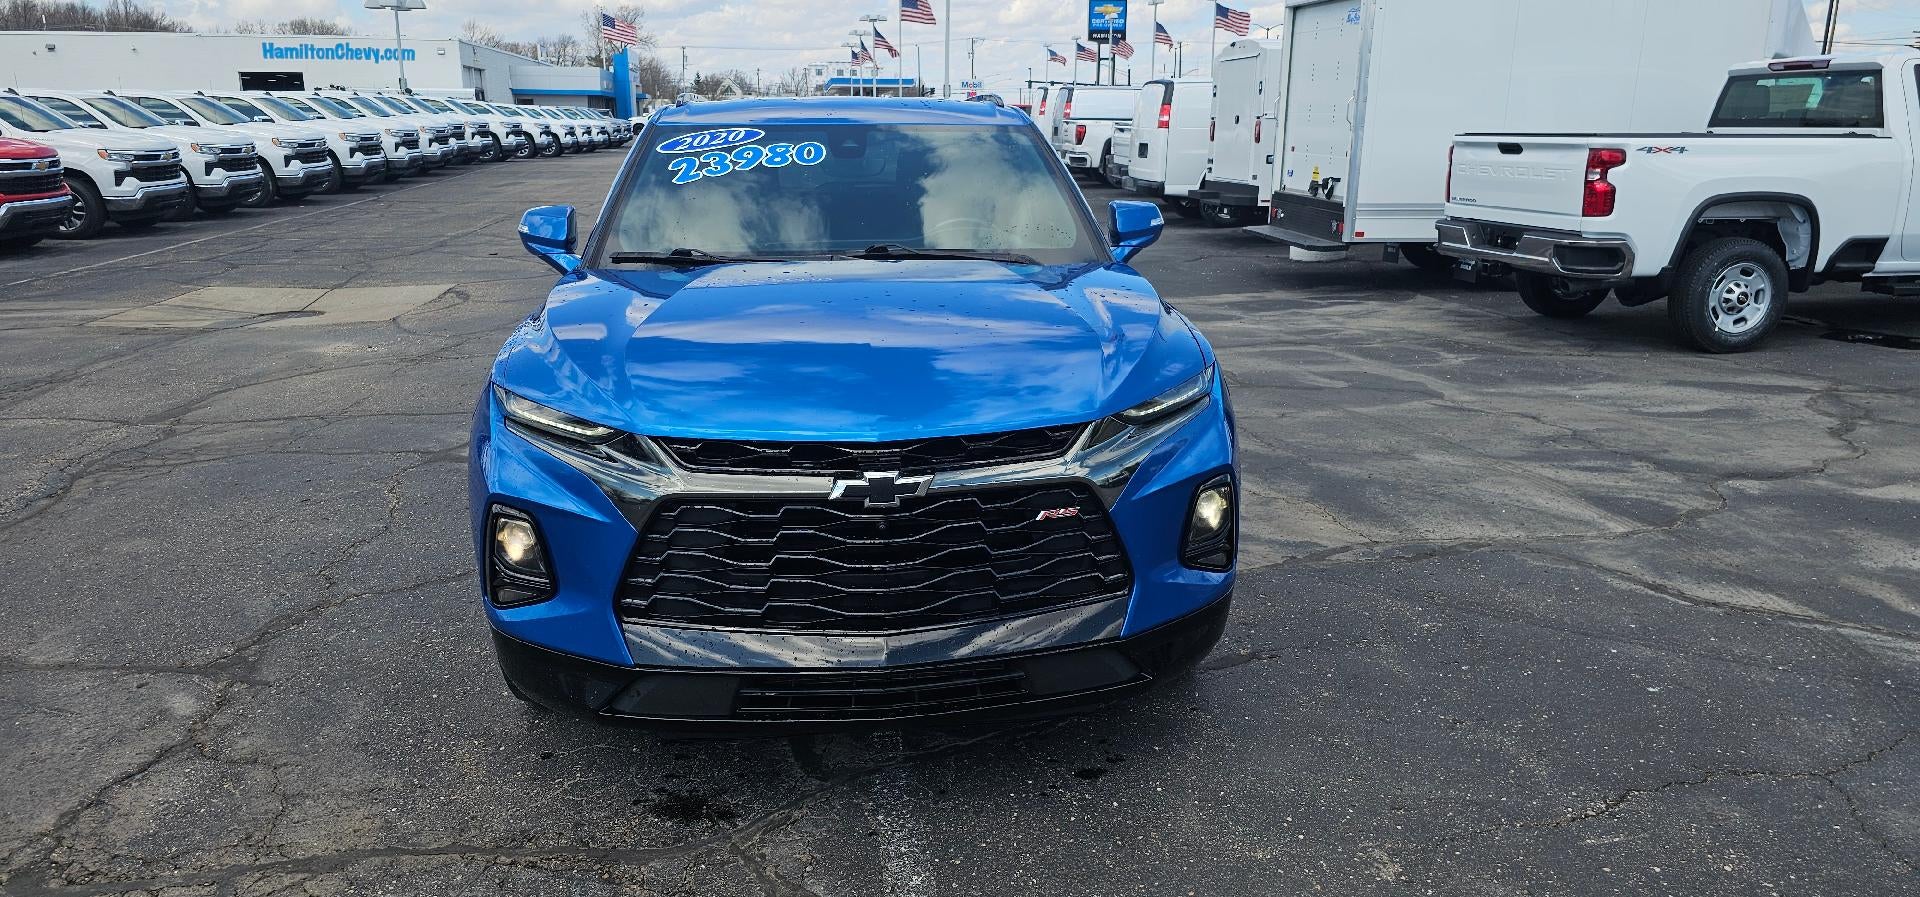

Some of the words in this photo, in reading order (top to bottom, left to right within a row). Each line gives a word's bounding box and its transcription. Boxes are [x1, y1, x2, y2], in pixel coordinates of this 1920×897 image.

[261, 42, 416, 64] HamiltonChevy.com
[961, 81, 983, 89] Mobil
[673, 129, 746, 151] 2020
[668, 141, 827, 185] 23980
[1455, 163, 1575, 181] CHEVROLET
[1035, 507, 1080, 521] RS
